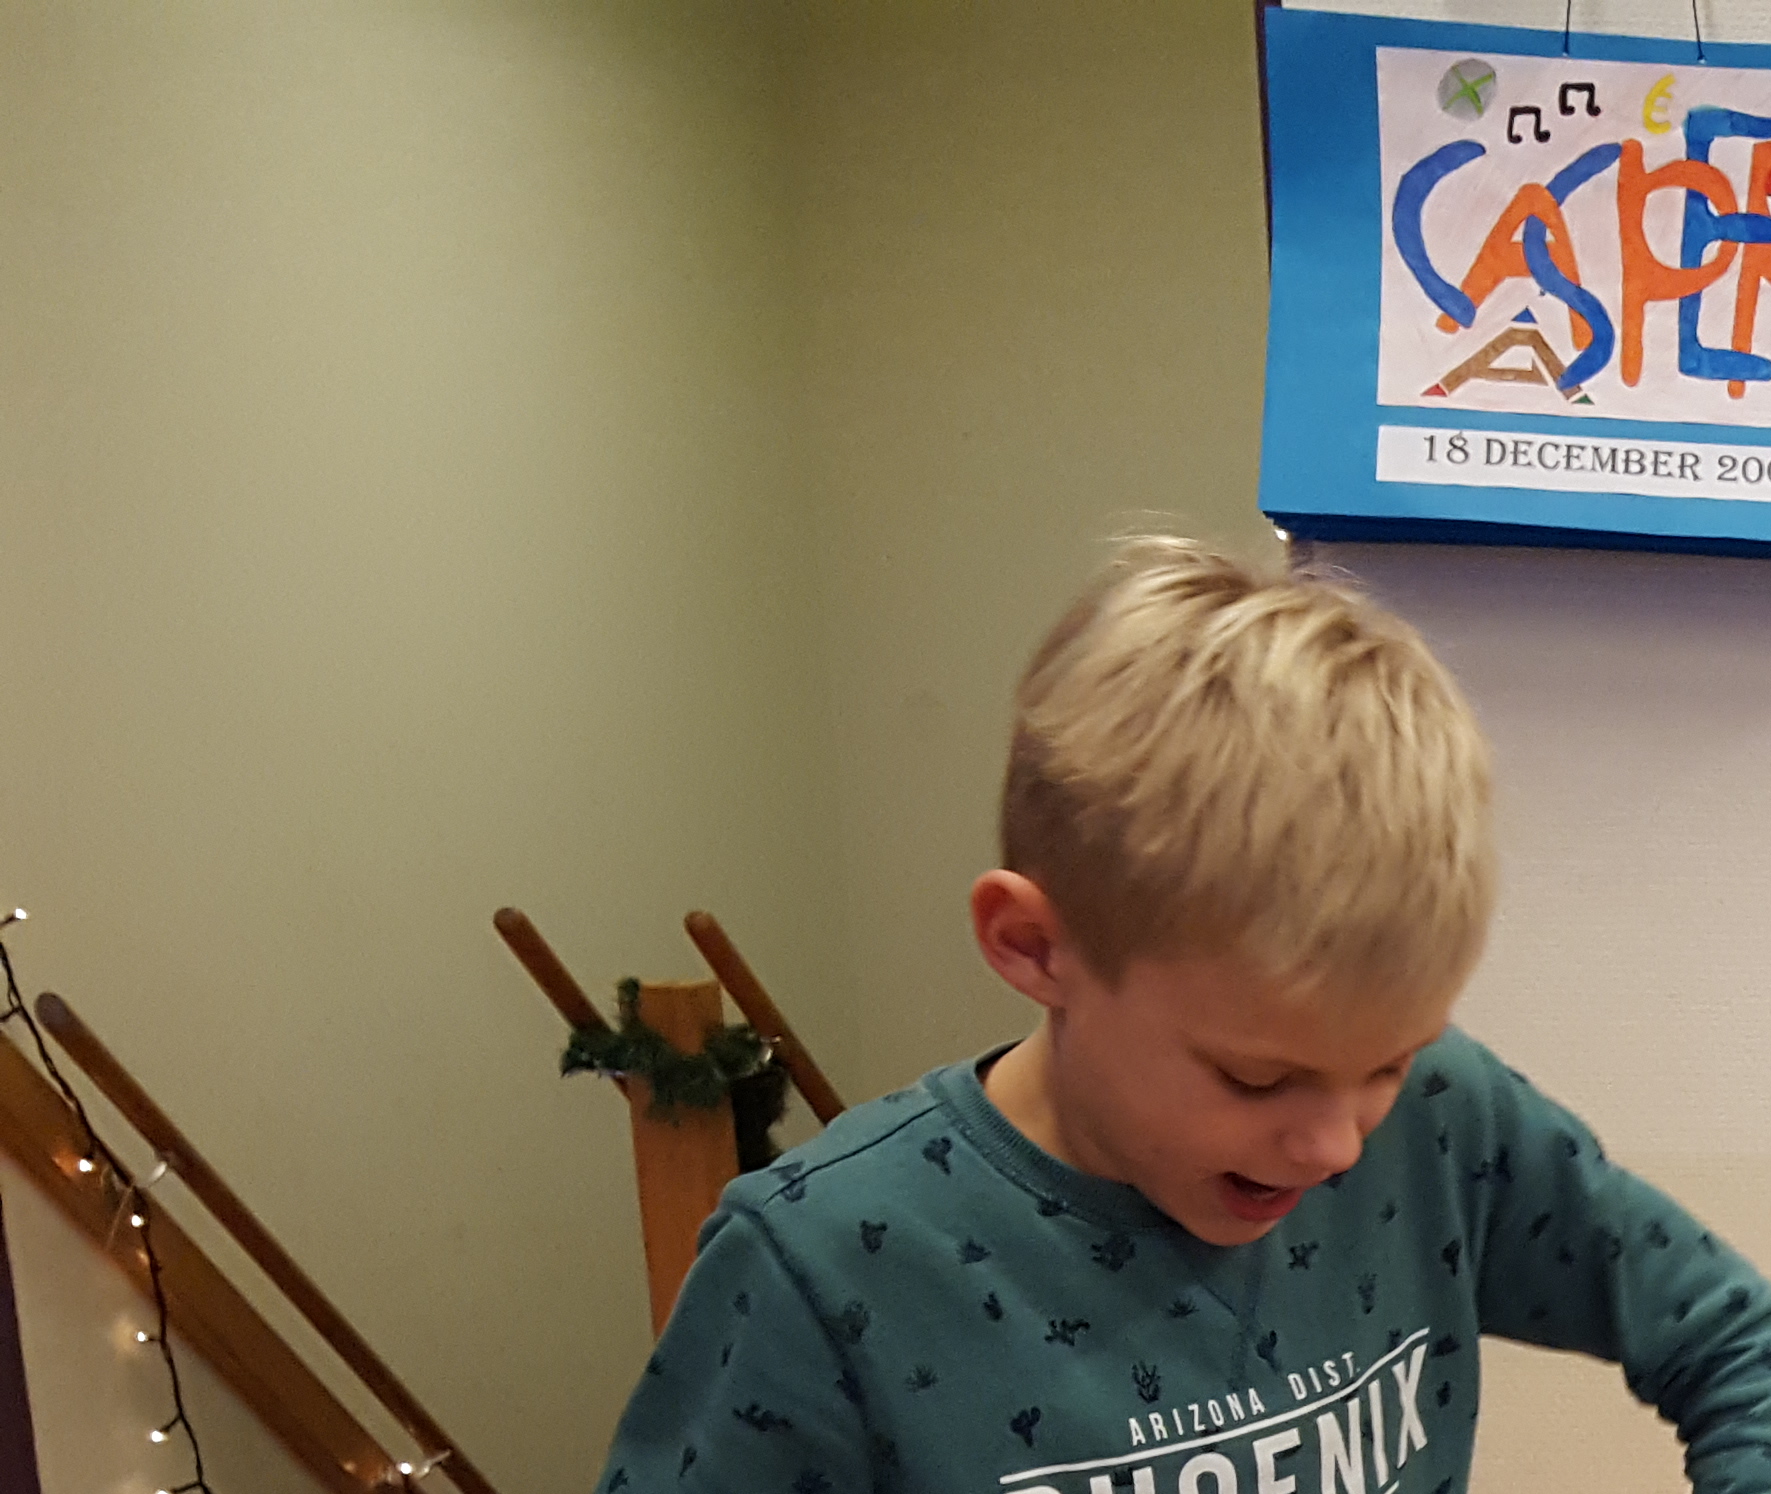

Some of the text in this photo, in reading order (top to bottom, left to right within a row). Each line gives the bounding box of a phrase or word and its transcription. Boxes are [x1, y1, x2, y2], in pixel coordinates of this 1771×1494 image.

[1423, 430, 1472, 465] 18
[1482, 437, 1701, 482] DECEMBER
[1127, 1351, 1361, 1447] ARIZONA DIST.
